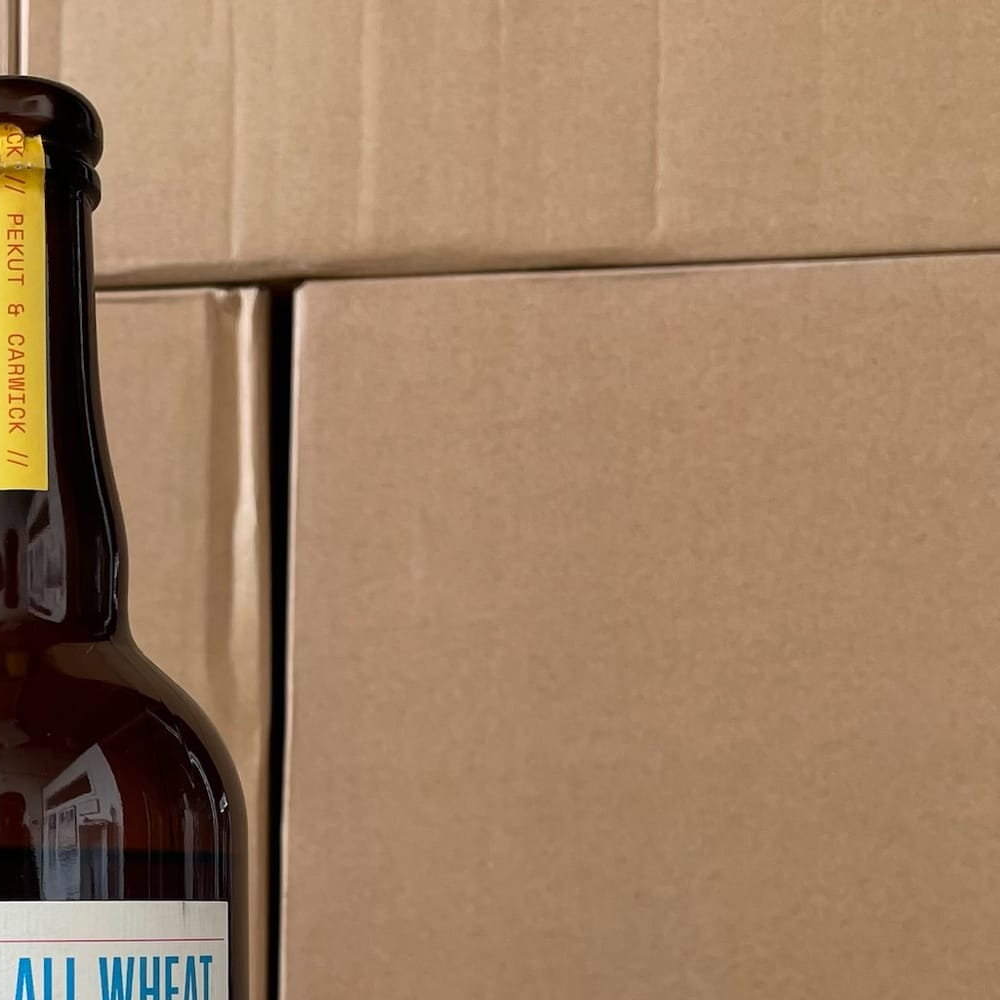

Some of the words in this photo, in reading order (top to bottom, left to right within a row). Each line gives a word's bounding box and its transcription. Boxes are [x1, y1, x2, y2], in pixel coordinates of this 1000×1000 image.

[6, 213, 25, 286] PEKUT
[7, 303, 25, 317] &
[7, 333, 26, 434] CARWICK
